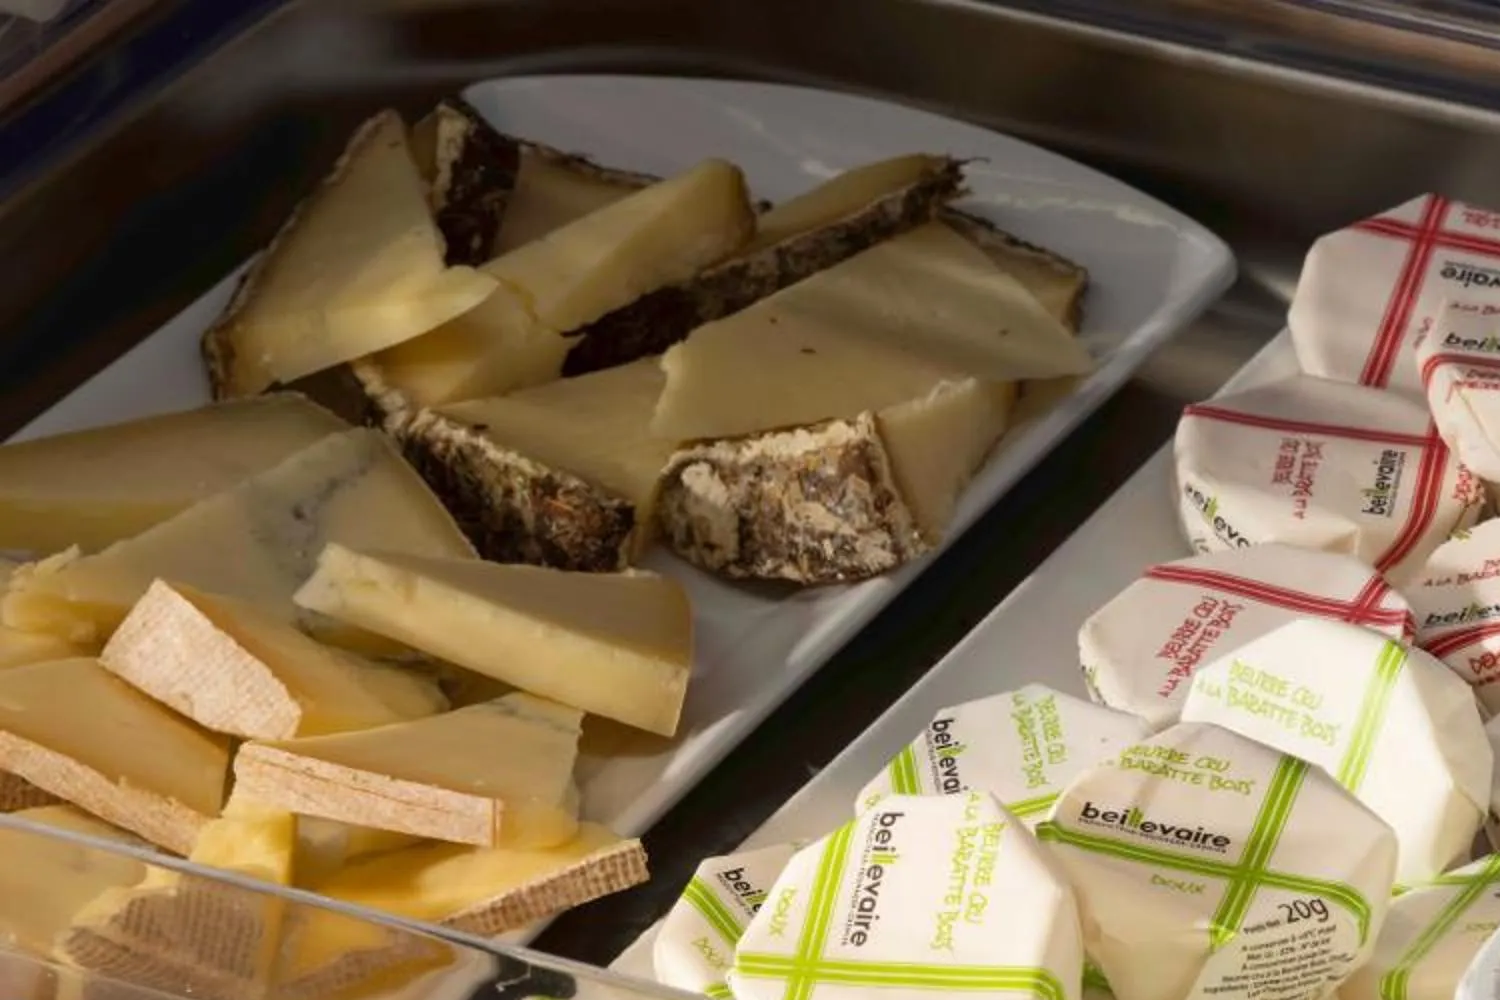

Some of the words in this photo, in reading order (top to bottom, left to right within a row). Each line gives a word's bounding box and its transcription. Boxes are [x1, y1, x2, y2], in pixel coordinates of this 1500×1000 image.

[932, 717, 969, 795] beillevai
[1118, 756, 1205, 786] BARATTE
[1194, 755, 1232, 774] CRU
[1080, 801, 1231, 849] beillevaire
[721, 867, 766, 917] beille
[849, 810, 906, 948] beillevaire
[1277, 898, 1330, 924] 20g
